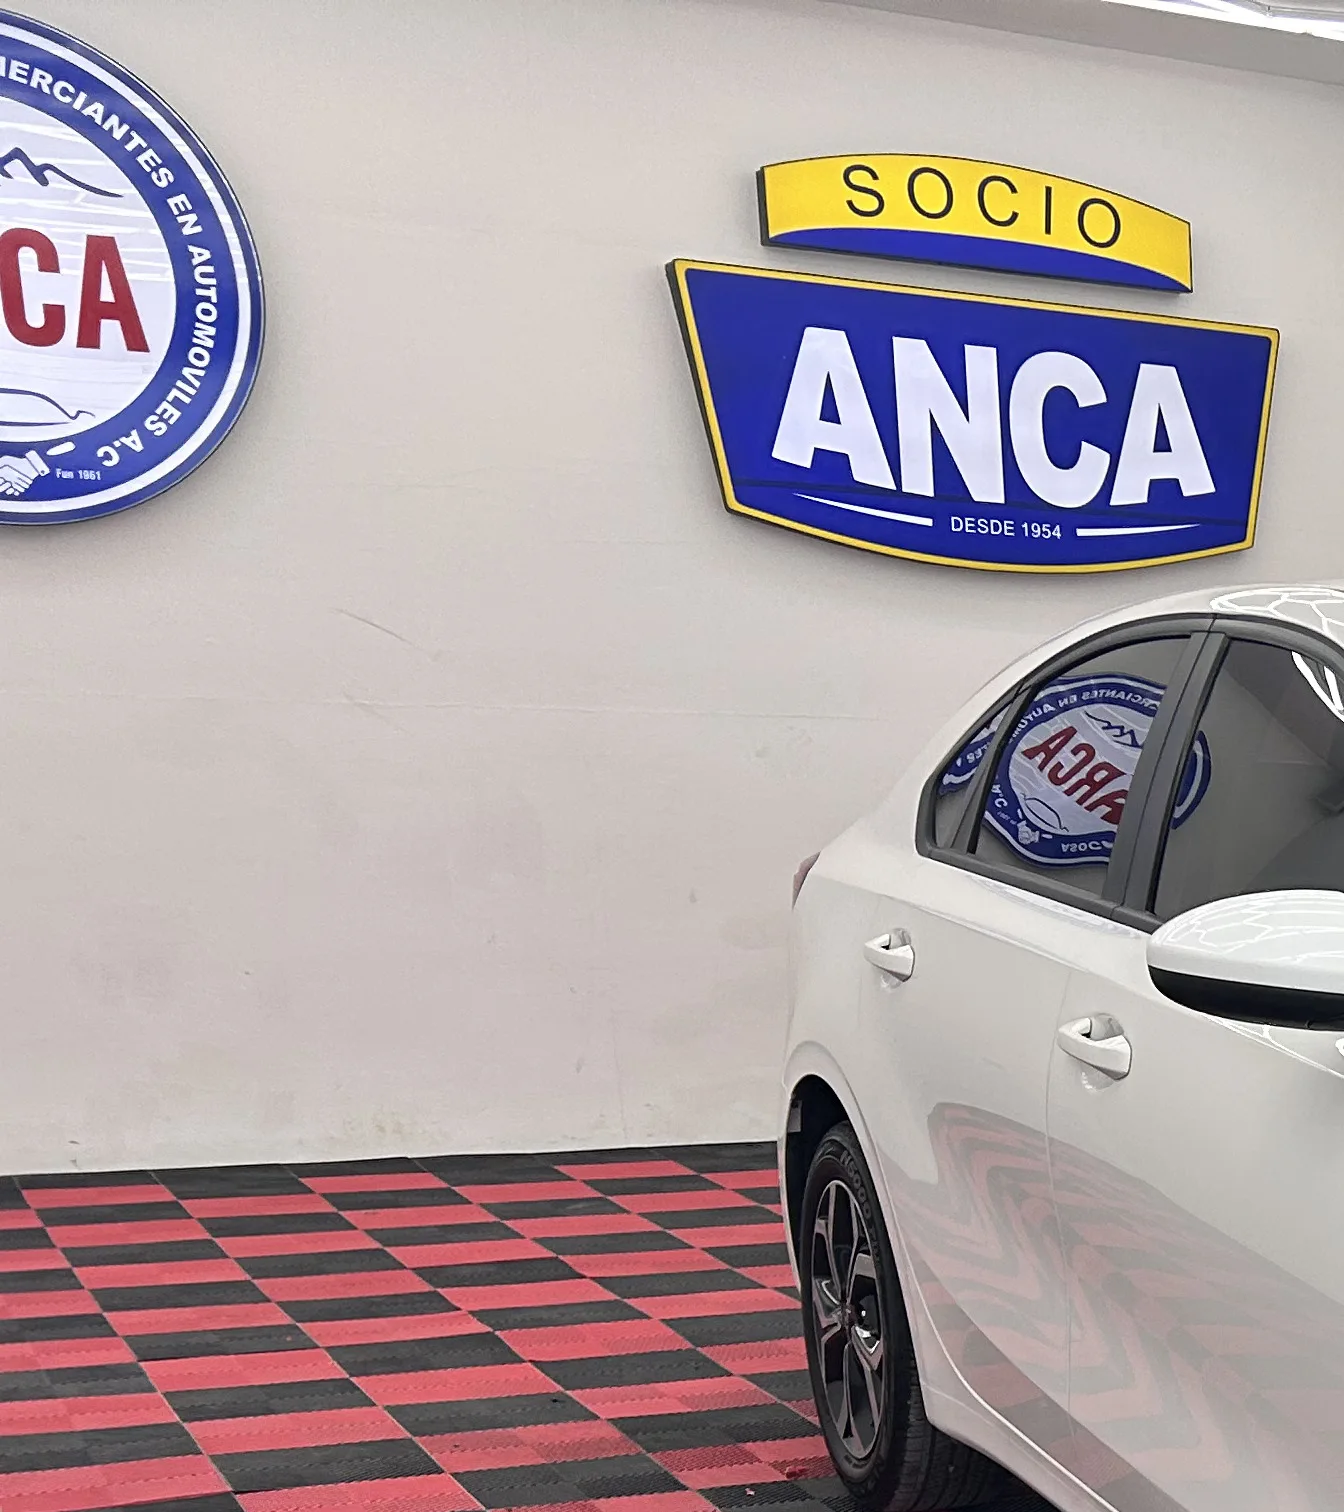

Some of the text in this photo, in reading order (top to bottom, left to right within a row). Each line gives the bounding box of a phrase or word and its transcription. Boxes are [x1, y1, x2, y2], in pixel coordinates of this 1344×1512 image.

[166, 193, 203, 236] EN
[842, 163, 1123, 250] SOCIO
[144, 244, 219, 437] AUTOMOVILES
[771, 325, 1216, 510] ANCA
[950, 516, 1062, 540] DESDE 1954
